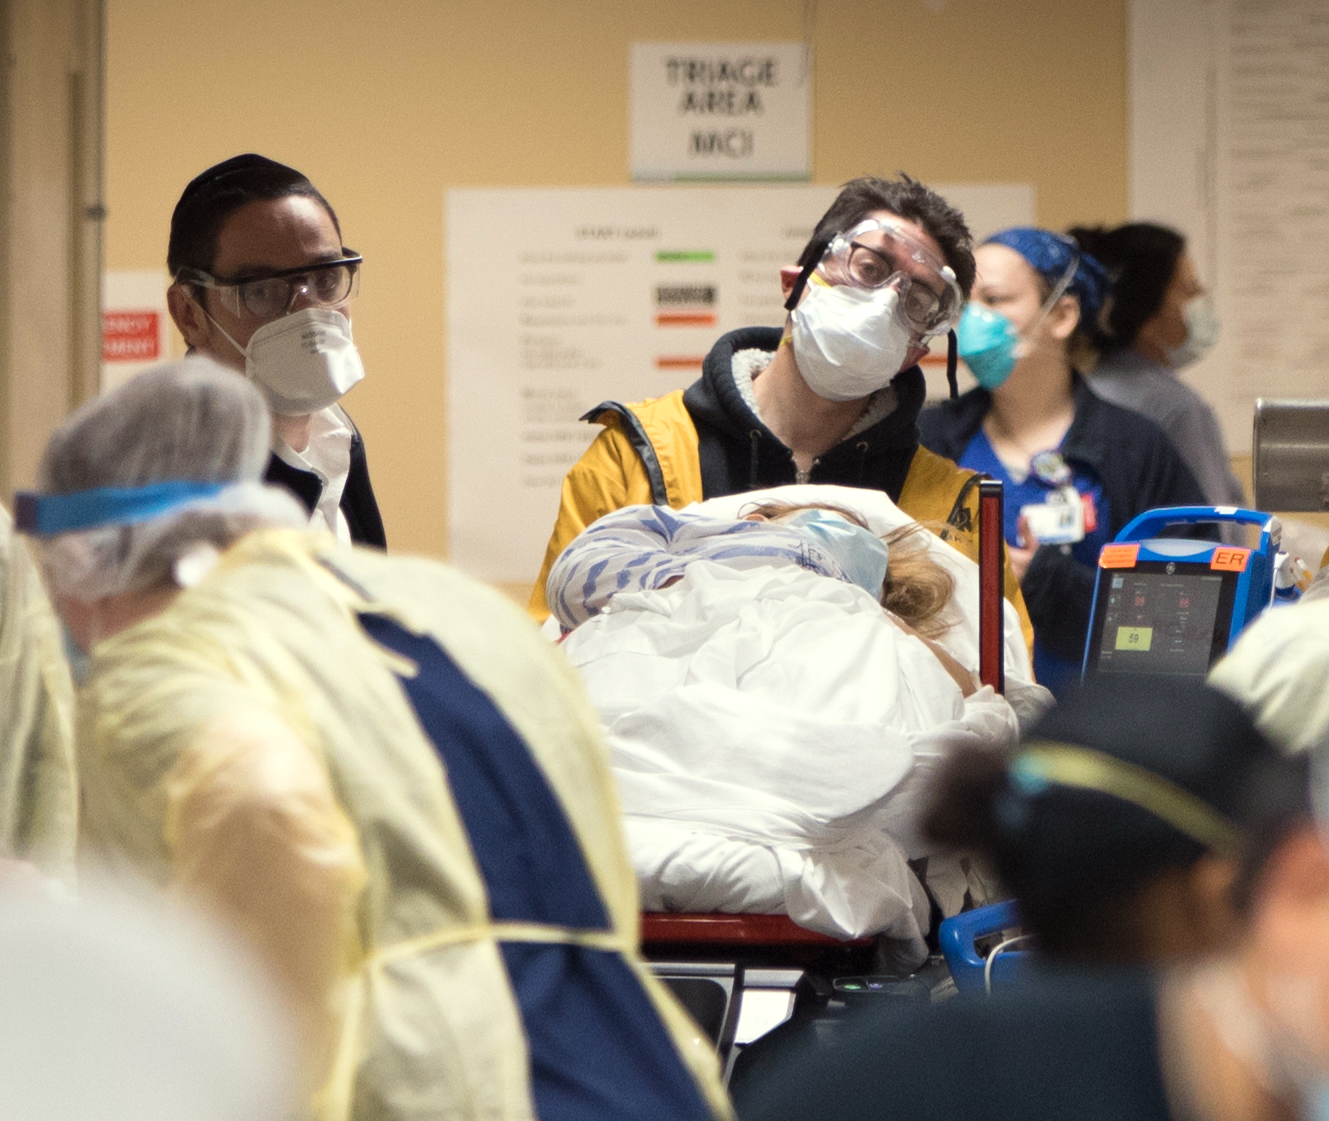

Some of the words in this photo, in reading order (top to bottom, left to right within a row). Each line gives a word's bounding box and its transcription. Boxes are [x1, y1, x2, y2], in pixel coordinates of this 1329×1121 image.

[666, 57, 776, 87] TRIAGE
[678, 89, 764, 117] AREA
[1215, 552, 1245, 567] ER
